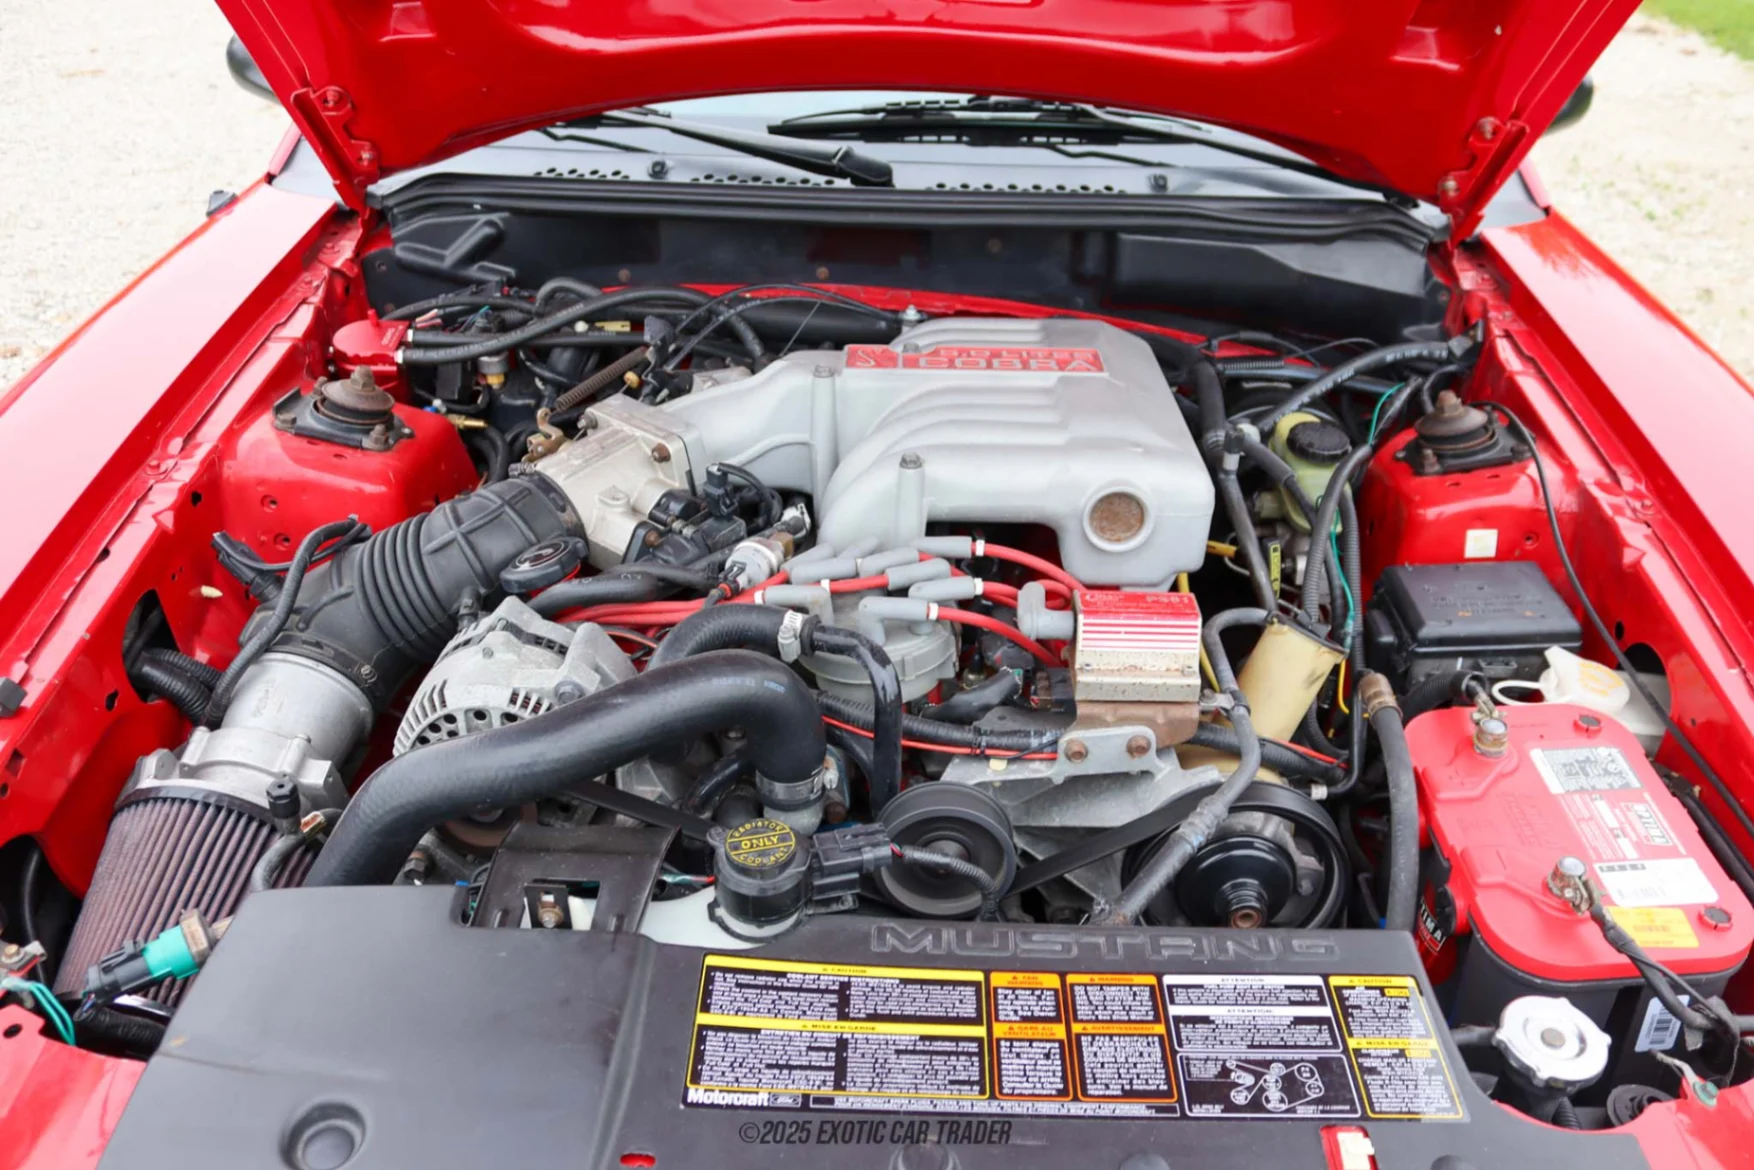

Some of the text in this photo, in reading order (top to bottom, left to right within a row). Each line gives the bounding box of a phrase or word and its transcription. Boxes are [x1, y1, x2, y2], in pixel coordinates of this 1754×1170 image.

[919, 356, 1100, 372] COBRA
[733, 820, 783, 837] RADIATOR
[741, 835, 779, 849] ONLY
[740, 847, 788, 864] COOLANT
[871, 922, 1340, 961] MUSTANG
[687, 1087, 770, 1107] Motorcraft
